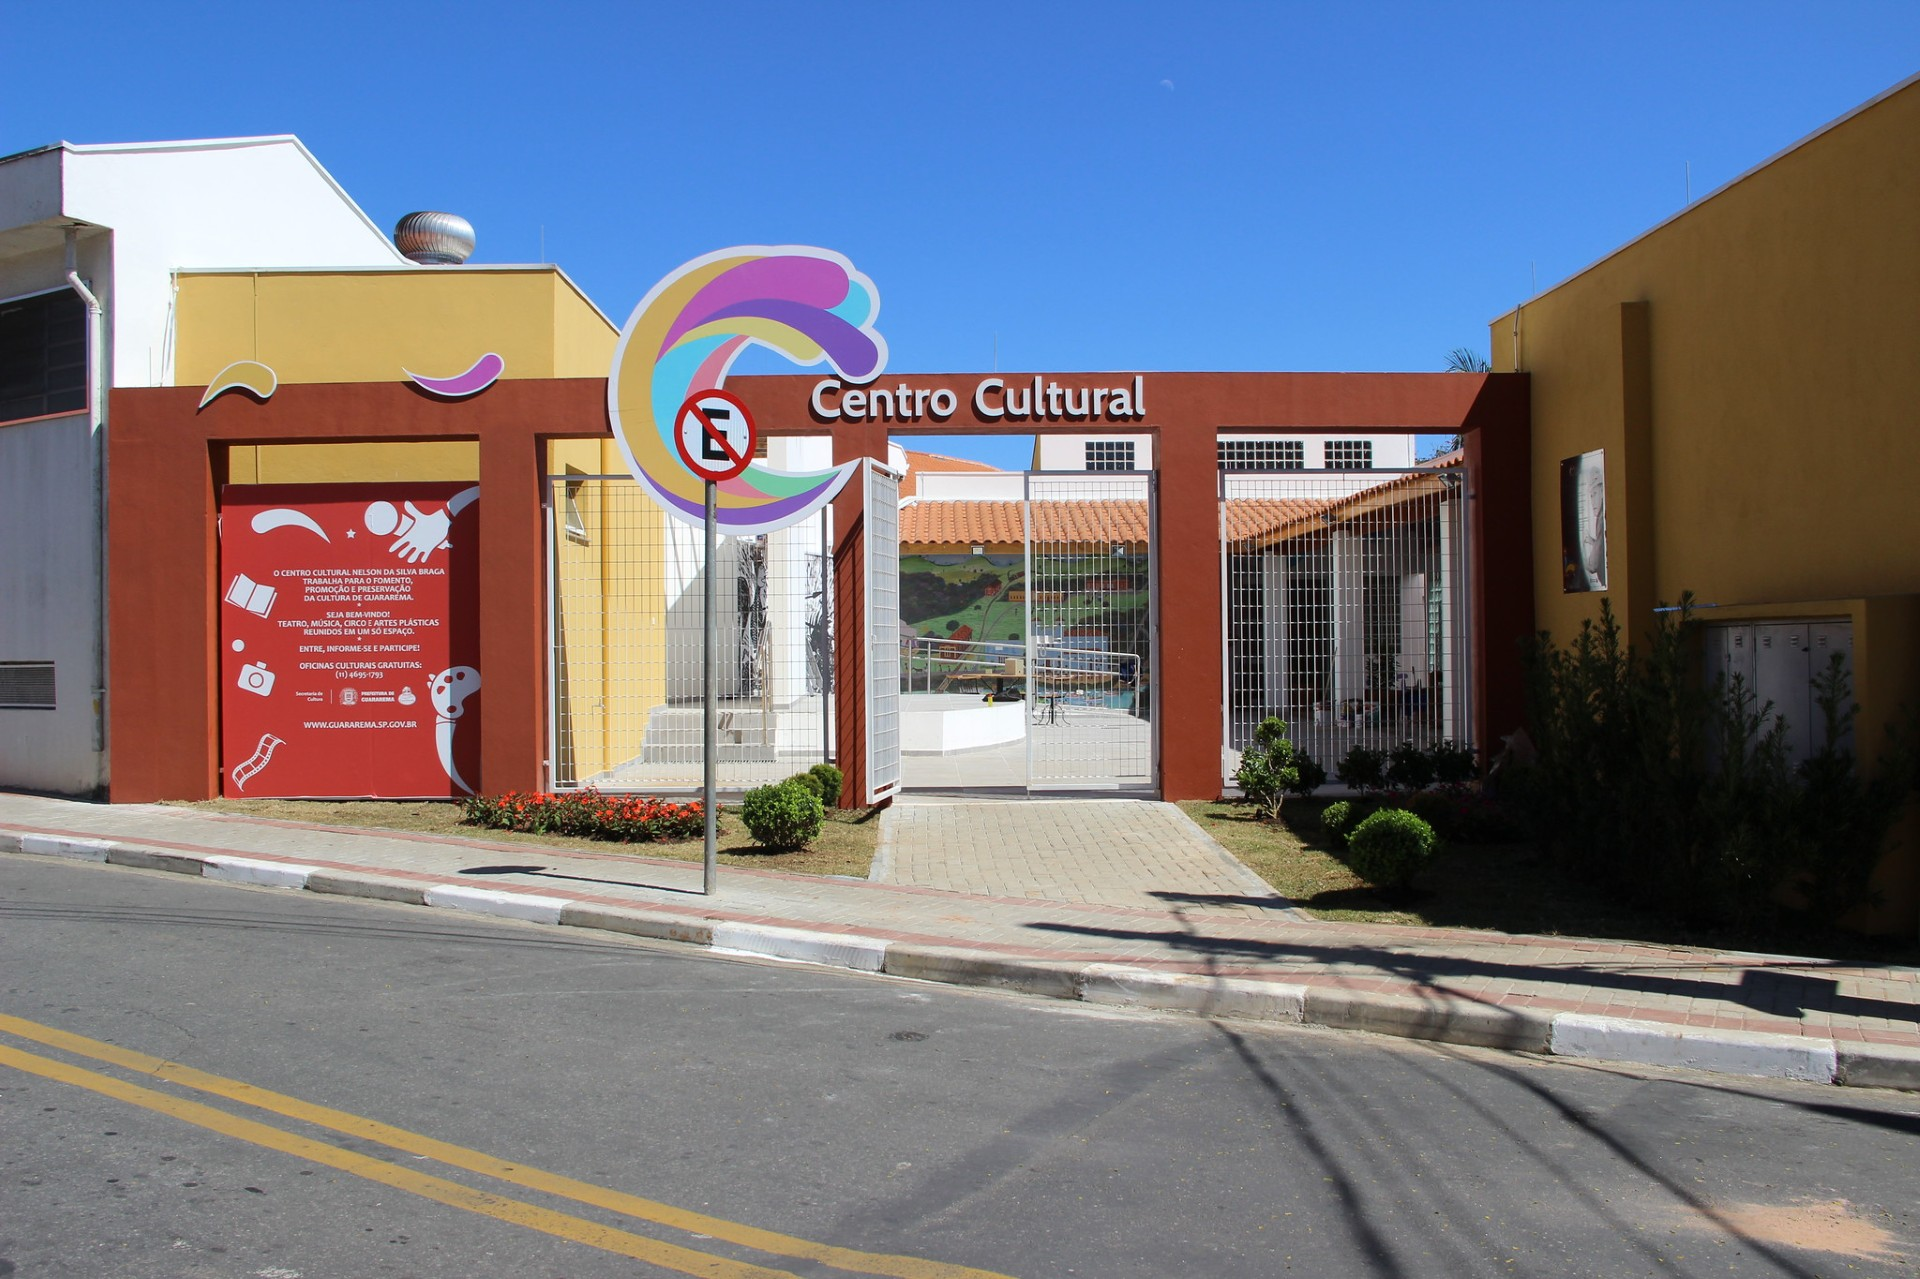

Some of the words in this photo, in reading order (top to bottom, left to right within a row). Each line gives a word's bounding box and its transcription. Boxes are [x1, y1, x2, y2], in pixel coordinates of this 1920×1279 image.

[811, 379, 957, 418] Centro
[975, 376, 1145, 416] Cultural
[702, 408, 730, 461] E
[305, 585, 349, 594] PROMOÇÃO
[358, 584, 411, 594] PRESERVAÇÃO
[311, 619, 342, 628] MÚSICA,
[400, 618, 439, 626] PLÁSTICAS
[371, 626, 382, 635] SÓ
[384, 628, 414, 636] ESPAÇO.
[336, 671, 348, 679] (11)
[304, 721, 416, 729] WWW.GUARAREMA.SP.GOV.BR
